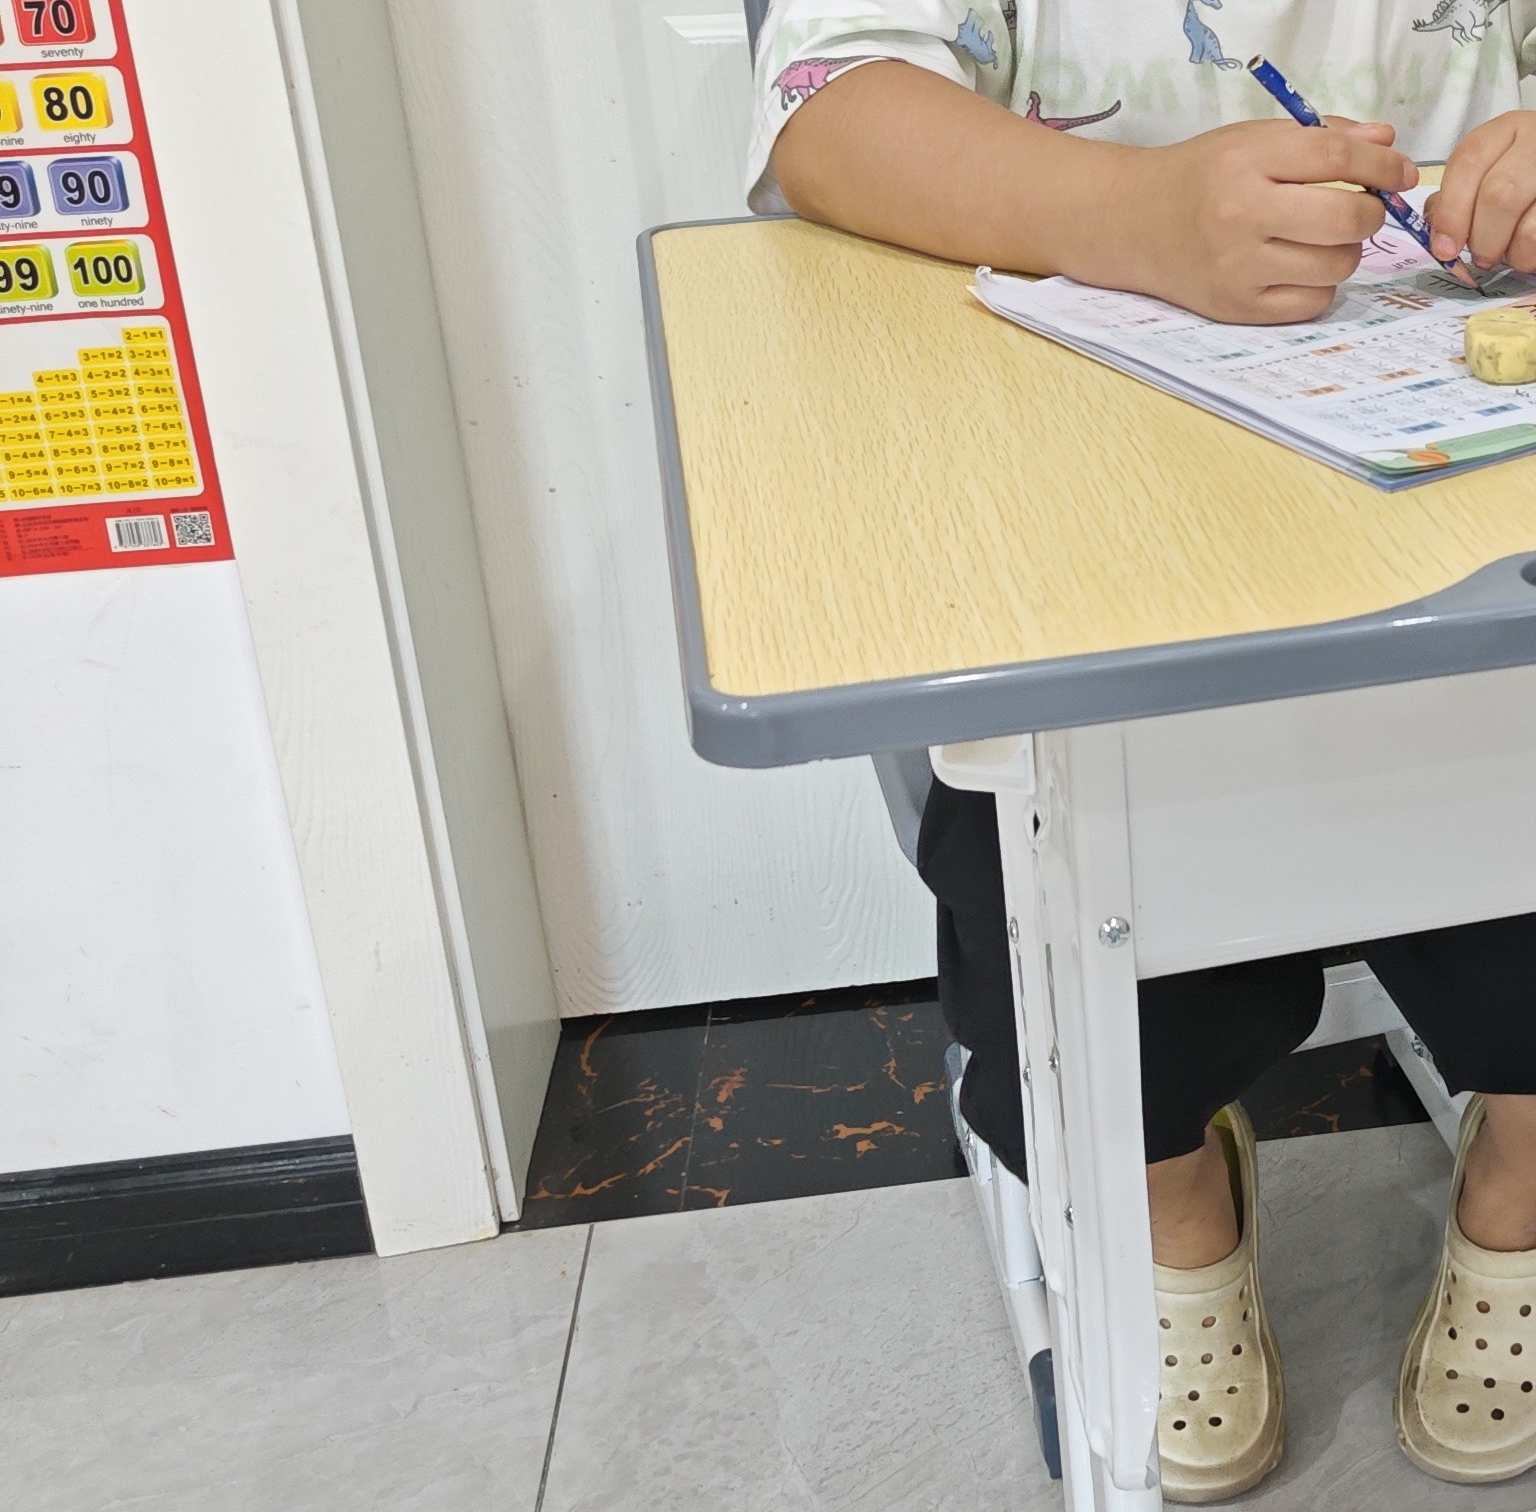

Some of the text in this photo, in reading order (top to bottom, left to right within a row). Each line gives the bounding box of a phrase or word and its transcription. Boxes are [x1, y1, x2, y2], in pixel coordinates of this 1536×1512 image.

[23, 0, 76, 36] 70
[41, 47, 84, 59] seventy
[43, 85, 94, 122] 80
[63, 132, 96, 146] eighty
[0, 175, 21, 209] 9
[61, 170, 111, 205] 90
[81, 216, 113, 227] ninety
[73, 255, 133, 285] 100
[0, 303, 53, 315] inety-nine
[78, 297, 144, 309] one hundred
